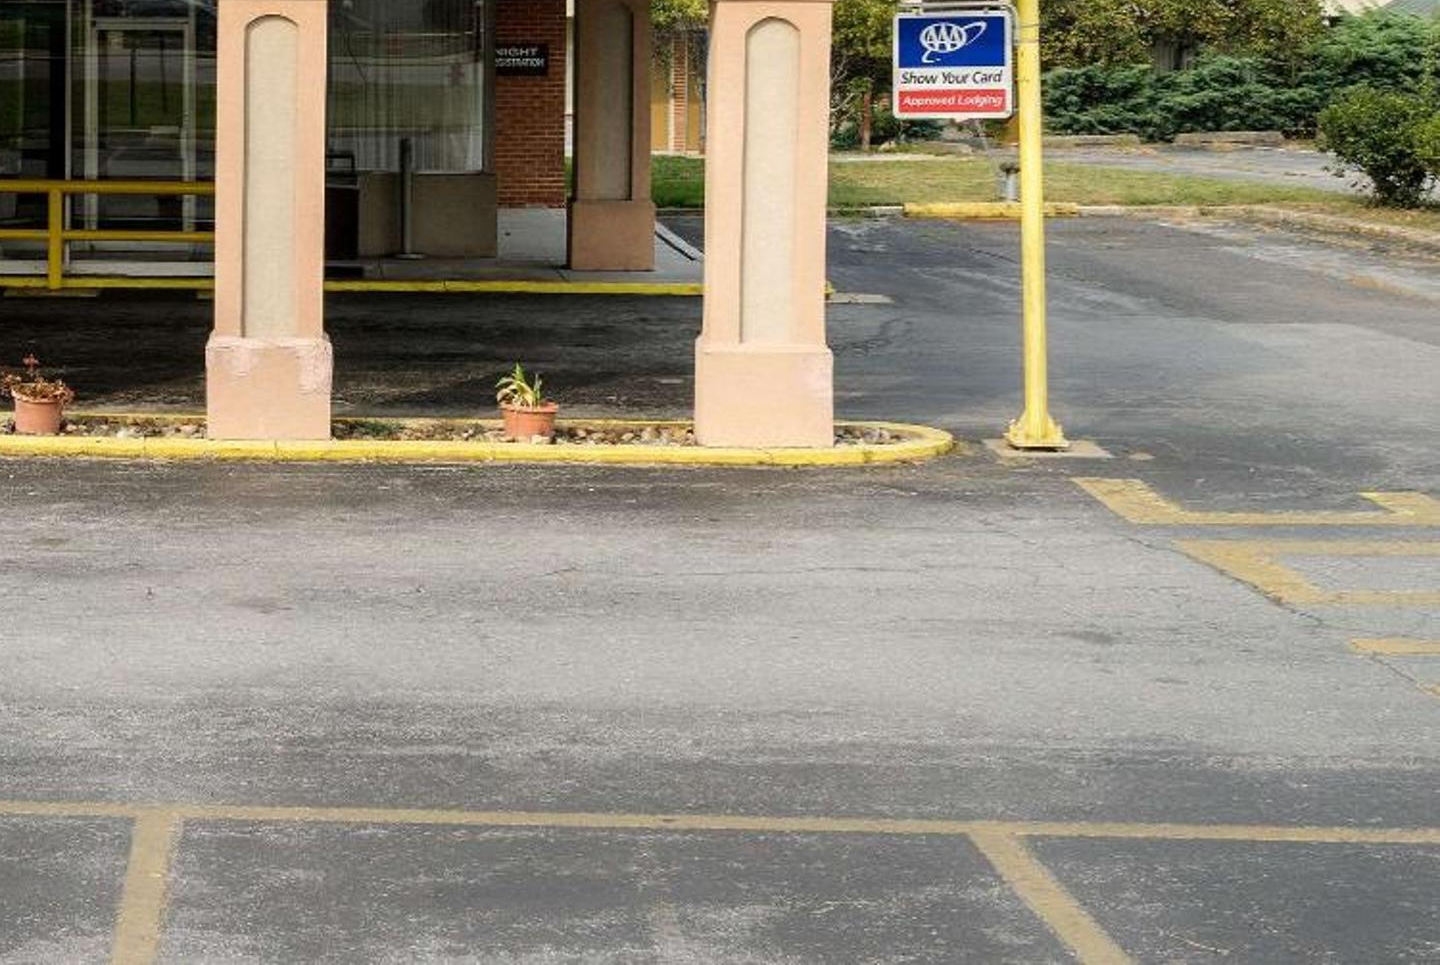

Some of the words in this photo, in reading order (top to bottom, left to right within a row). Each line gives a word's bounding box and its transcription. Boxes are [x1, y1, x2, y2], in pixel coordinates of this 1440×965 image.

[901, 71, 937, 84] Show
[941, 72, 969, 83] Your
[972, 70, 1003, 83] Card
[902, 95, 956, 107] Approved
[957, 94, 1003, 107] Lodging
